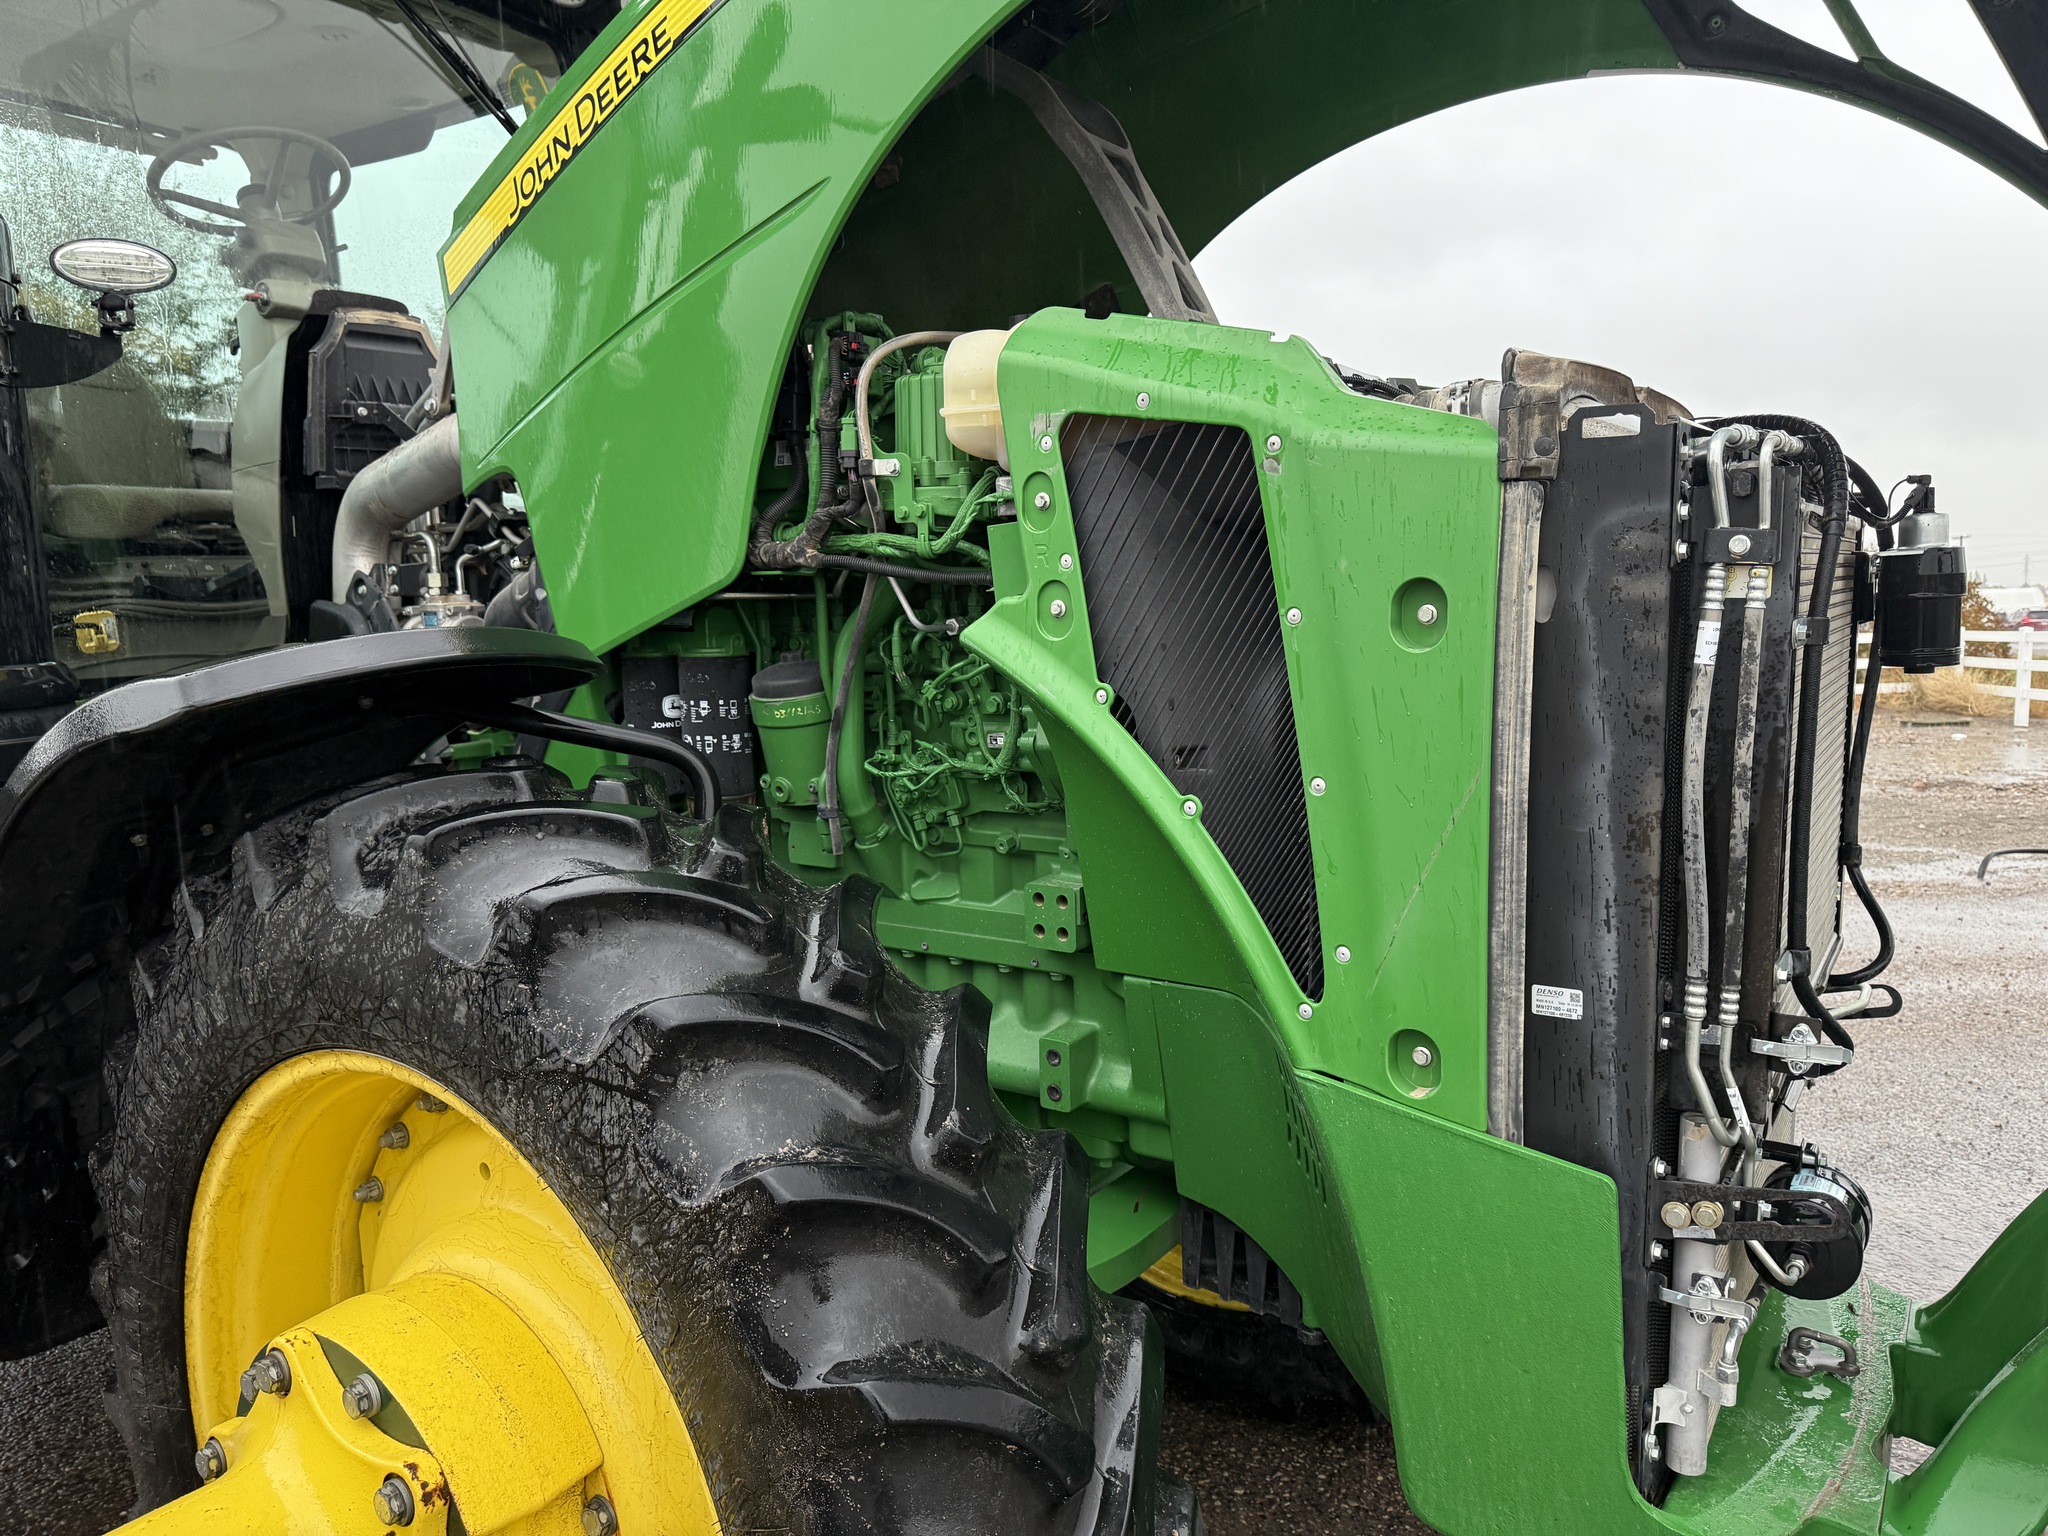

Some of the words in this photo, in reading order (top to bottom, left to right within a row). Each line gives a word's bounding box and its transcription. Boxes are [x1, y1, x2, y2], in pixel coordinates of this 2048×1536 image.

[508, 123, 573, 219] JOHN
[574, 15, 674, 142] DEERE
[1034, 543, 1050, 568] R
[651, 721, 675, 729] JOHN
[1536, 988, 1564, 997] DENSO
